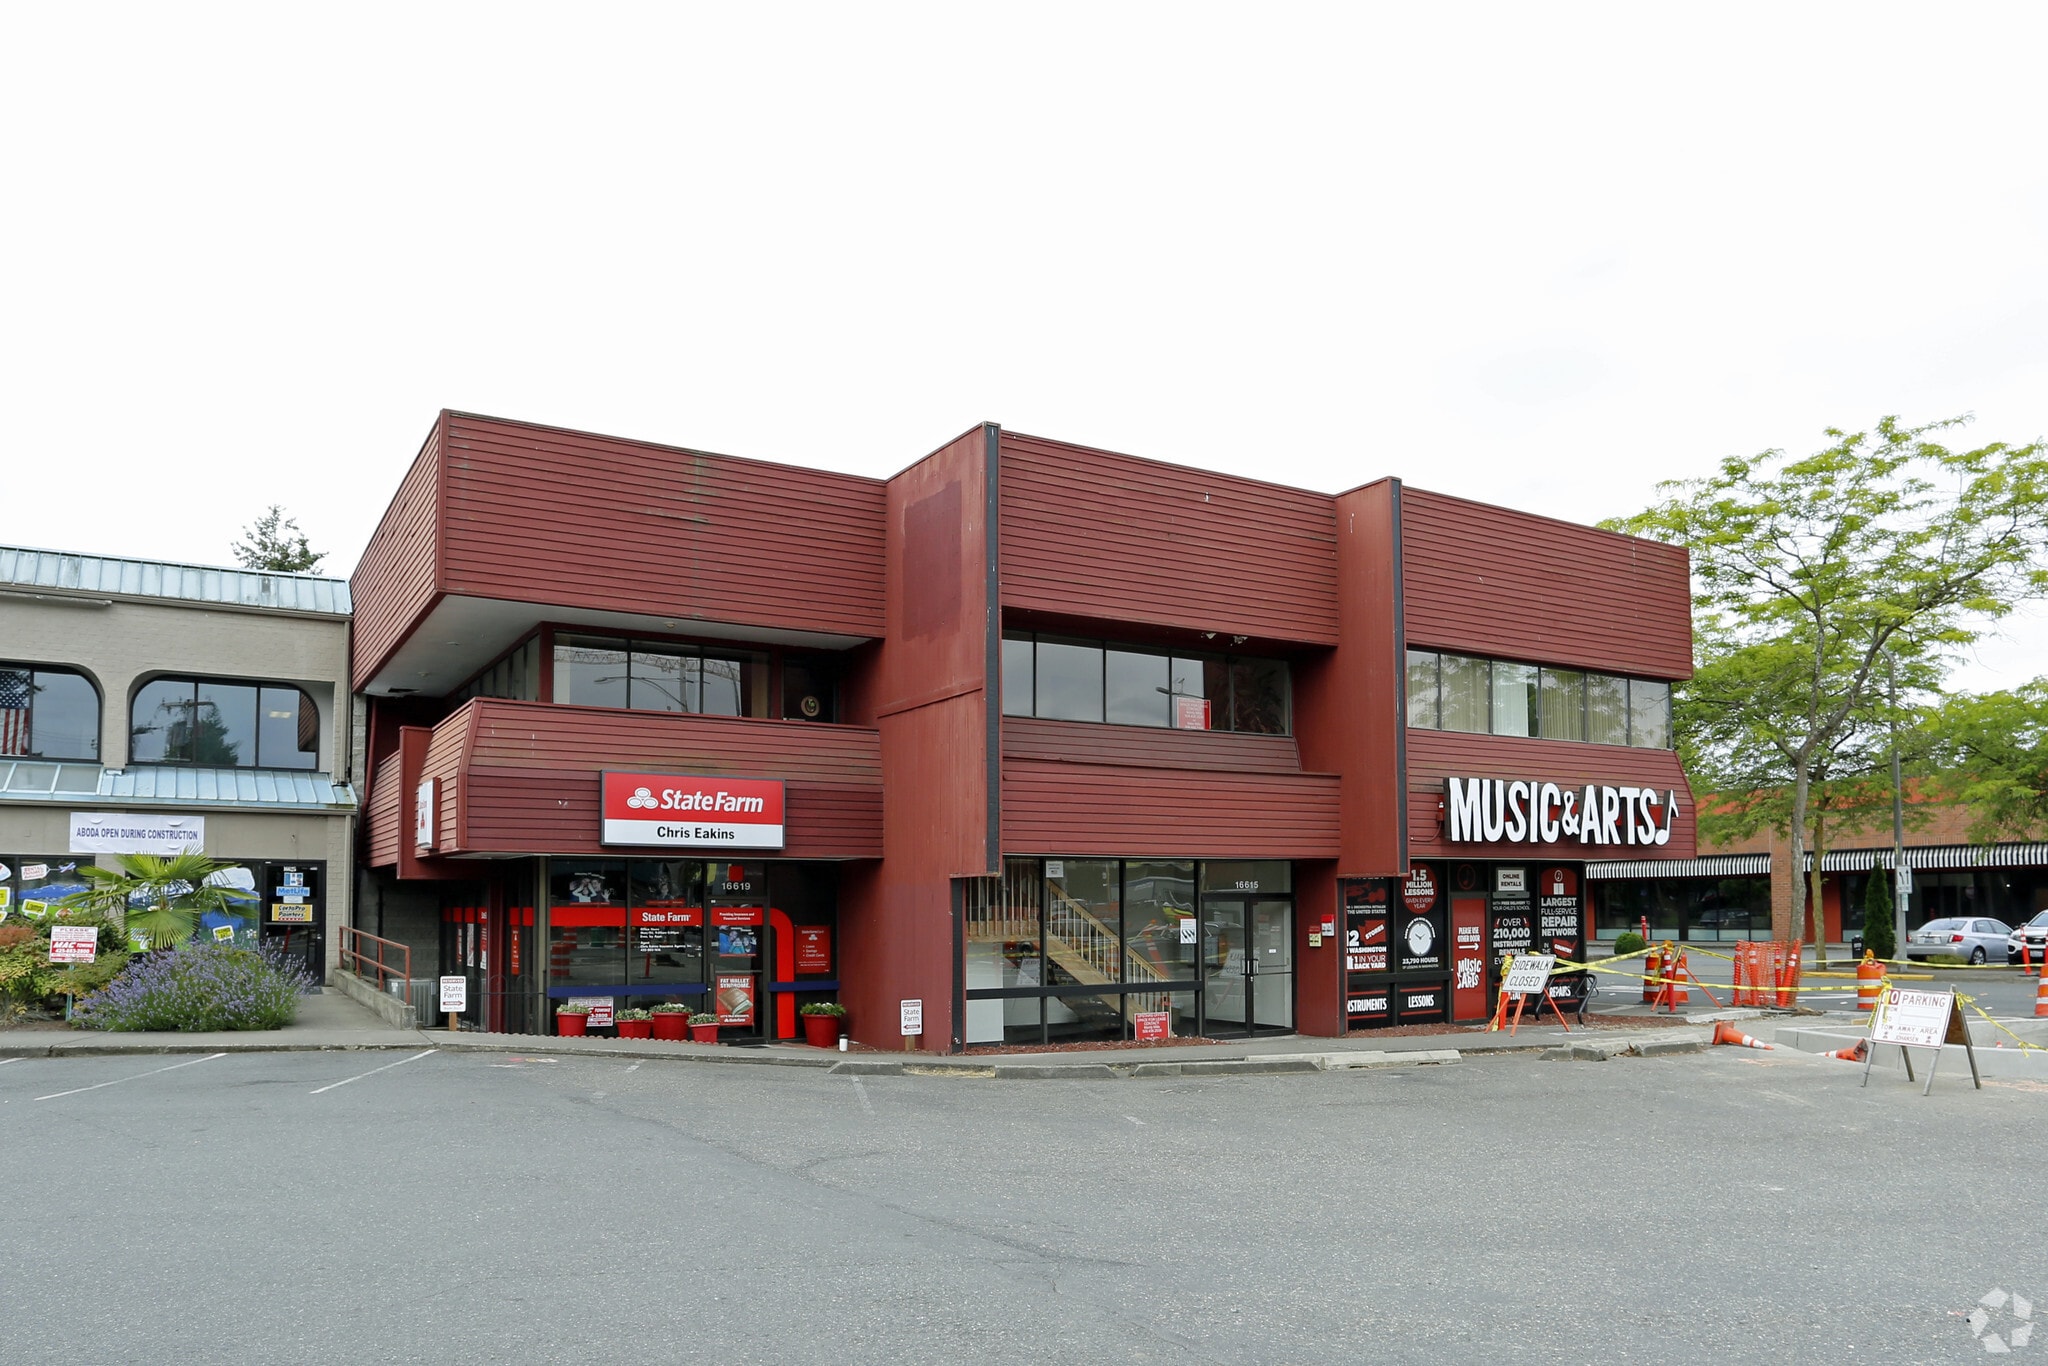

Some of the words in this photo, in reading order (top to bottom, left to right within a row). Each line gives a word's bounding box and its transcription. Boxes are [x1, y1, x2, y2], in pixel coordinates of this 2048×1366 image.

[76, 827, 99, 838] ABODA
[100, 828, 119, 838] OPEN
[120, 829, 146, 839] DURING
[148, 830, 198, 840] CONSTRUCTION
[657, 826, 690, 838] Chris
[694, 828, 735, 840] Eakins
[1411, 870, 1426, 881] 1.5
[722, 882, 751, 890] 16619
[1236, 880, 1258, 889] 16615
[1541, 897, 1577, 906] LARGEST
[642, 912, 665, 922] State
[667, 912, 689, 922] Farm
[1502, 918, 1521, 926] OVER
[1541, 916, 1577, 927] REPAIR
[1365, 924, 1385, 940] STORES
[1494, 928, 1530, 940] 210,000
[1541, 928, 1577, 936] NETWORK
[1458, 958, 1482, 974] MUSIC
[1512, 960, 1551, 970] SIDEWALK
[1509, 976, 1540, 986] CLOSED
[1347, 998, 1387, 1012] NSTRUMENTS
[1408, 995, 1434, 1008] LESSONS
[1902, 994, 1946, 1007] PARKING
